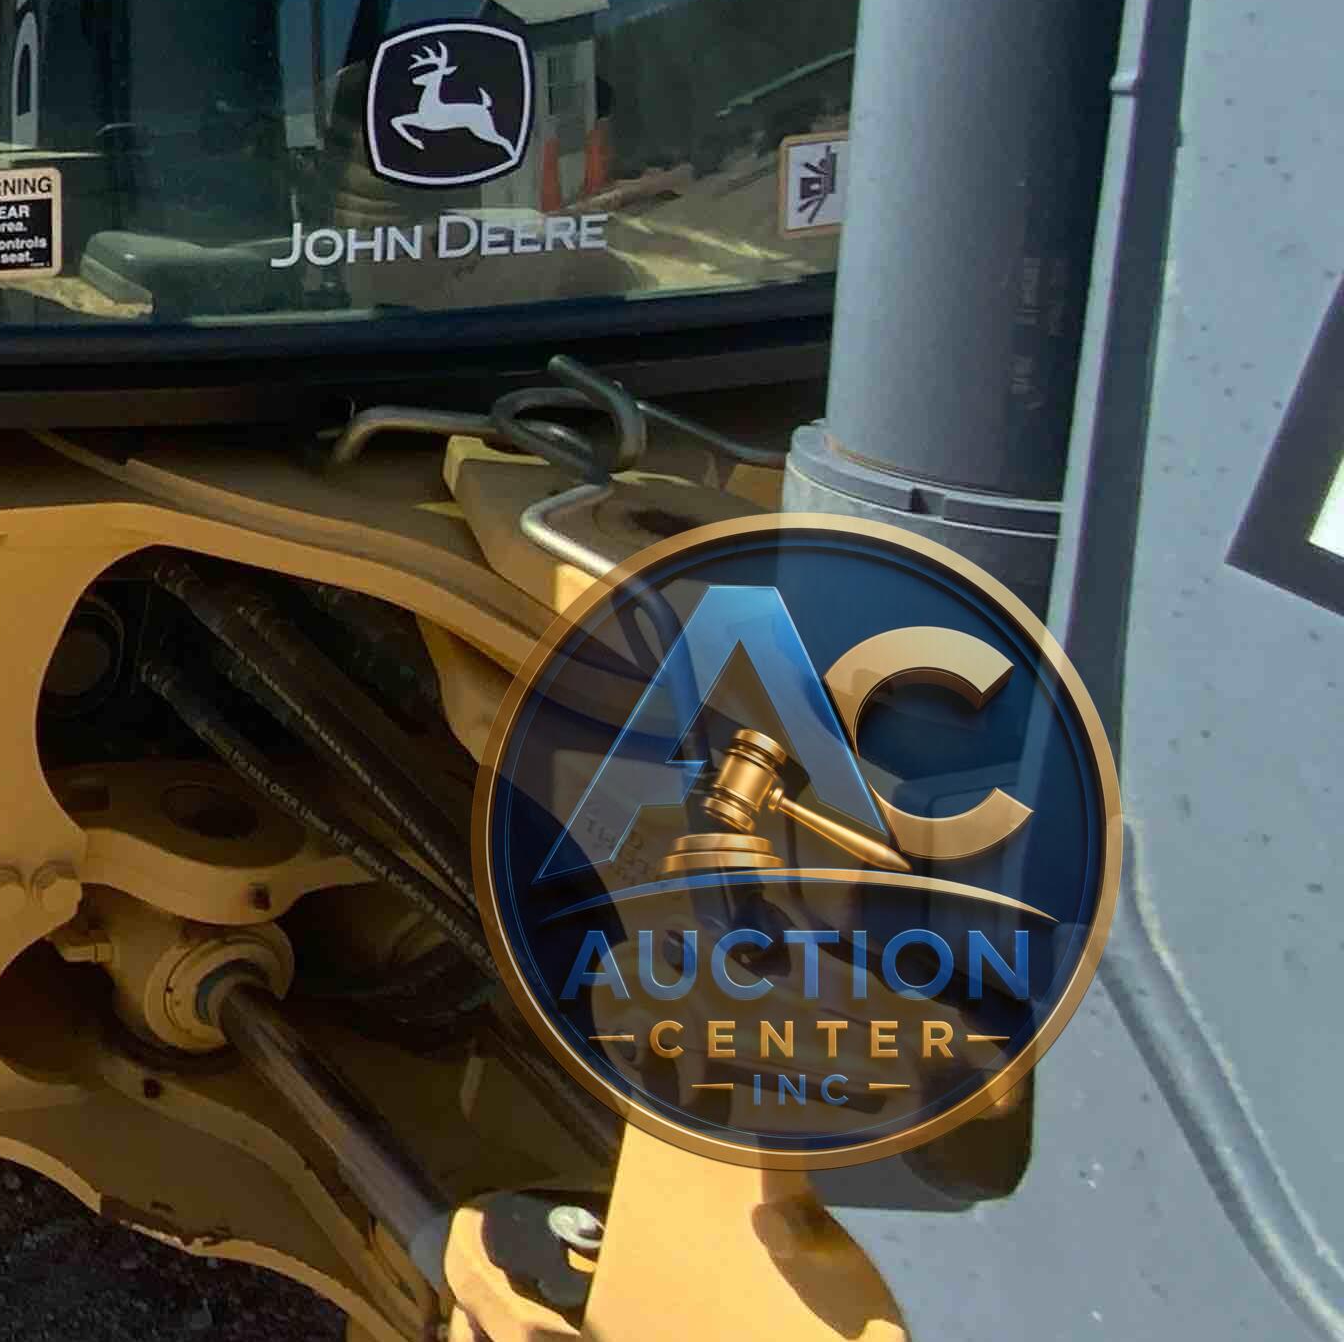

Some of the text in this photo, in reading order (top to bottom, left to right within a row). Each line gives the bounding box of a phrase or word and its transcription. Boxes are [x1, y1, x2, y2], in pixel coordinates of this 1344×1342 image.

[0, 249, 33, 265] seat.
[270, 214, 610, 269] JOHN DEERE
